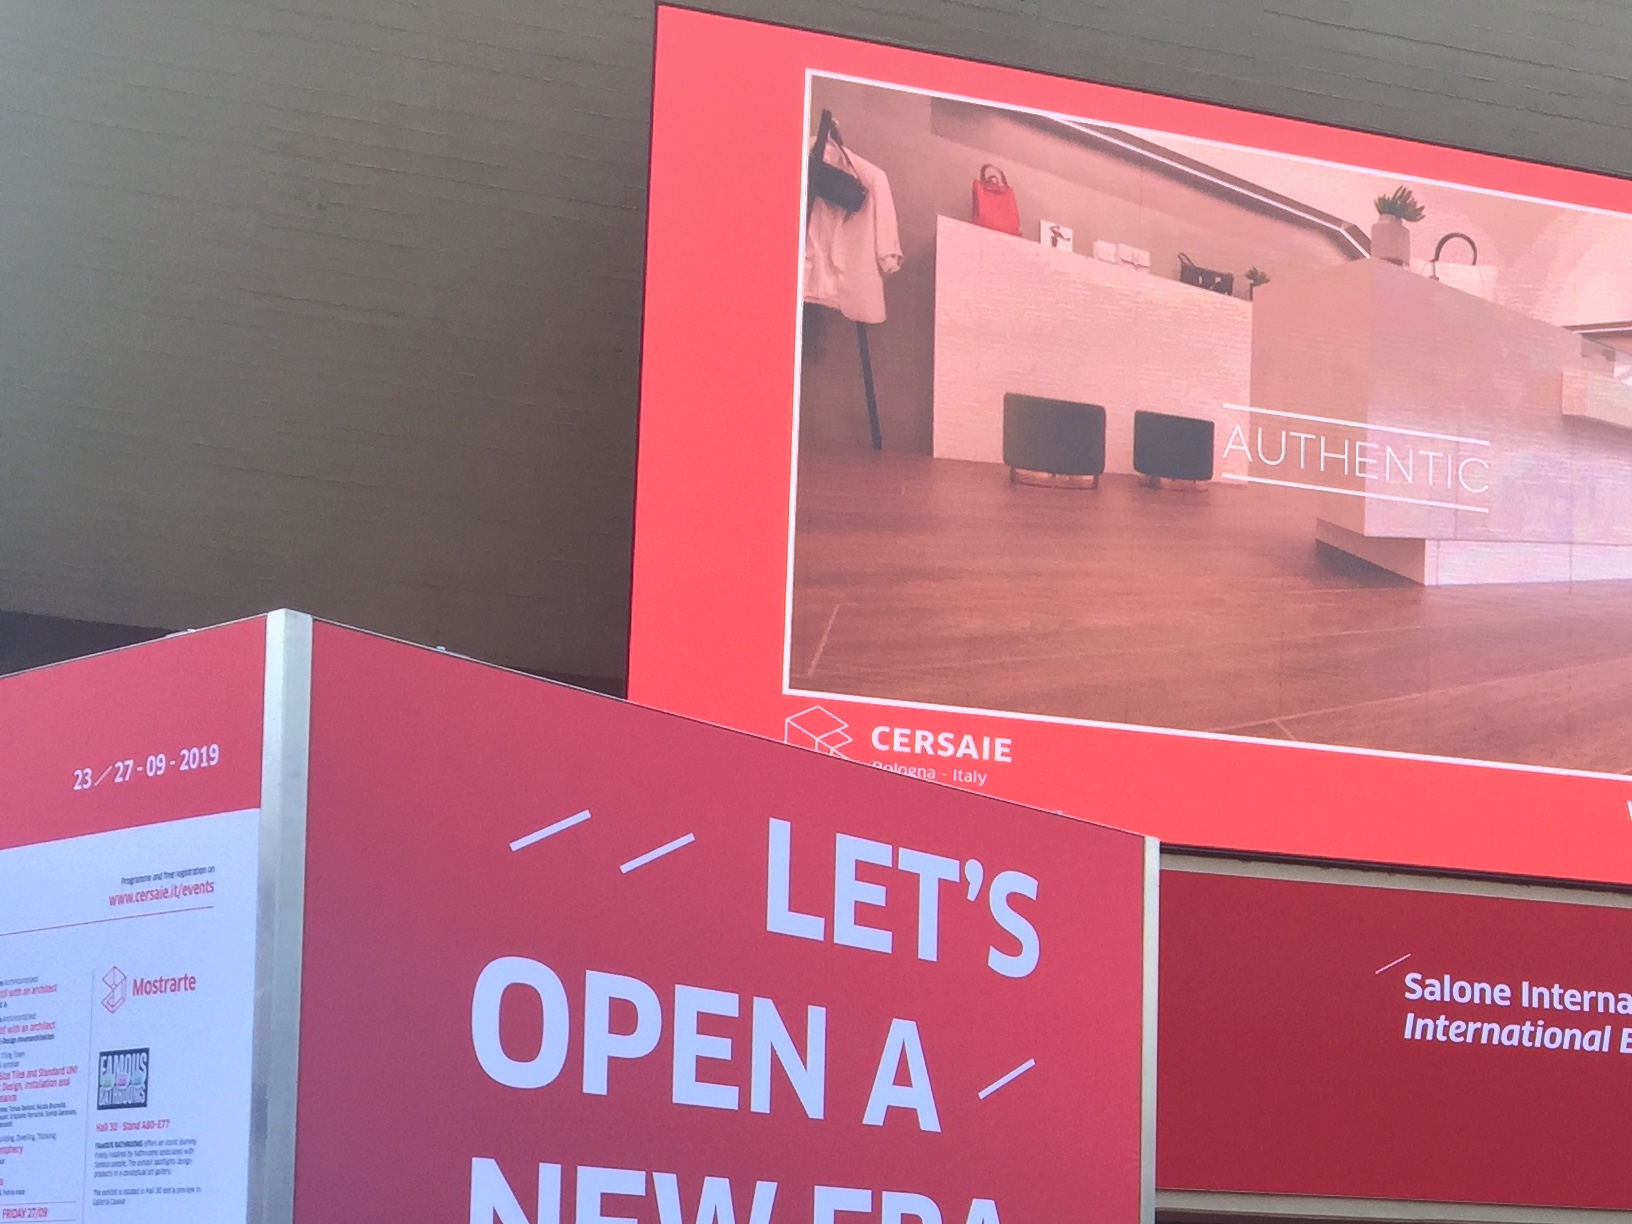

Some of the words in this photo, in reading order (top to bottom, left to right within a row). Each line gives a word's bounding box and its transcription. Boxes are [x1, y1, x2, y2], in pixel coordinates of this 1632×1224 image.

[1222, 424, 1489, 493] AUTHENTIC
[871, 726, 1013, 763] CERSAIE
[73, 768, 92, 791] 23
[114, 760, 134, 783] 27
[146, 754, 166, 777] 09
[179, 744, 220, 771] 2019
[953, 769, 988, 786] Italy
[108, 880, 215, 906] www.cersaie.it/events
[767, 817, 1041, 978] LET'S
[132, 973, 197, 997] Mostrarte
[1404, 972, 1512, 1007] Salone
[471, 955, 827, 1120] OPEN
[862, 1017, 941, 1133] A
[1403, 1012, 1611, 1053] International
[2, 1208, 26, 1219] FRIDAY
